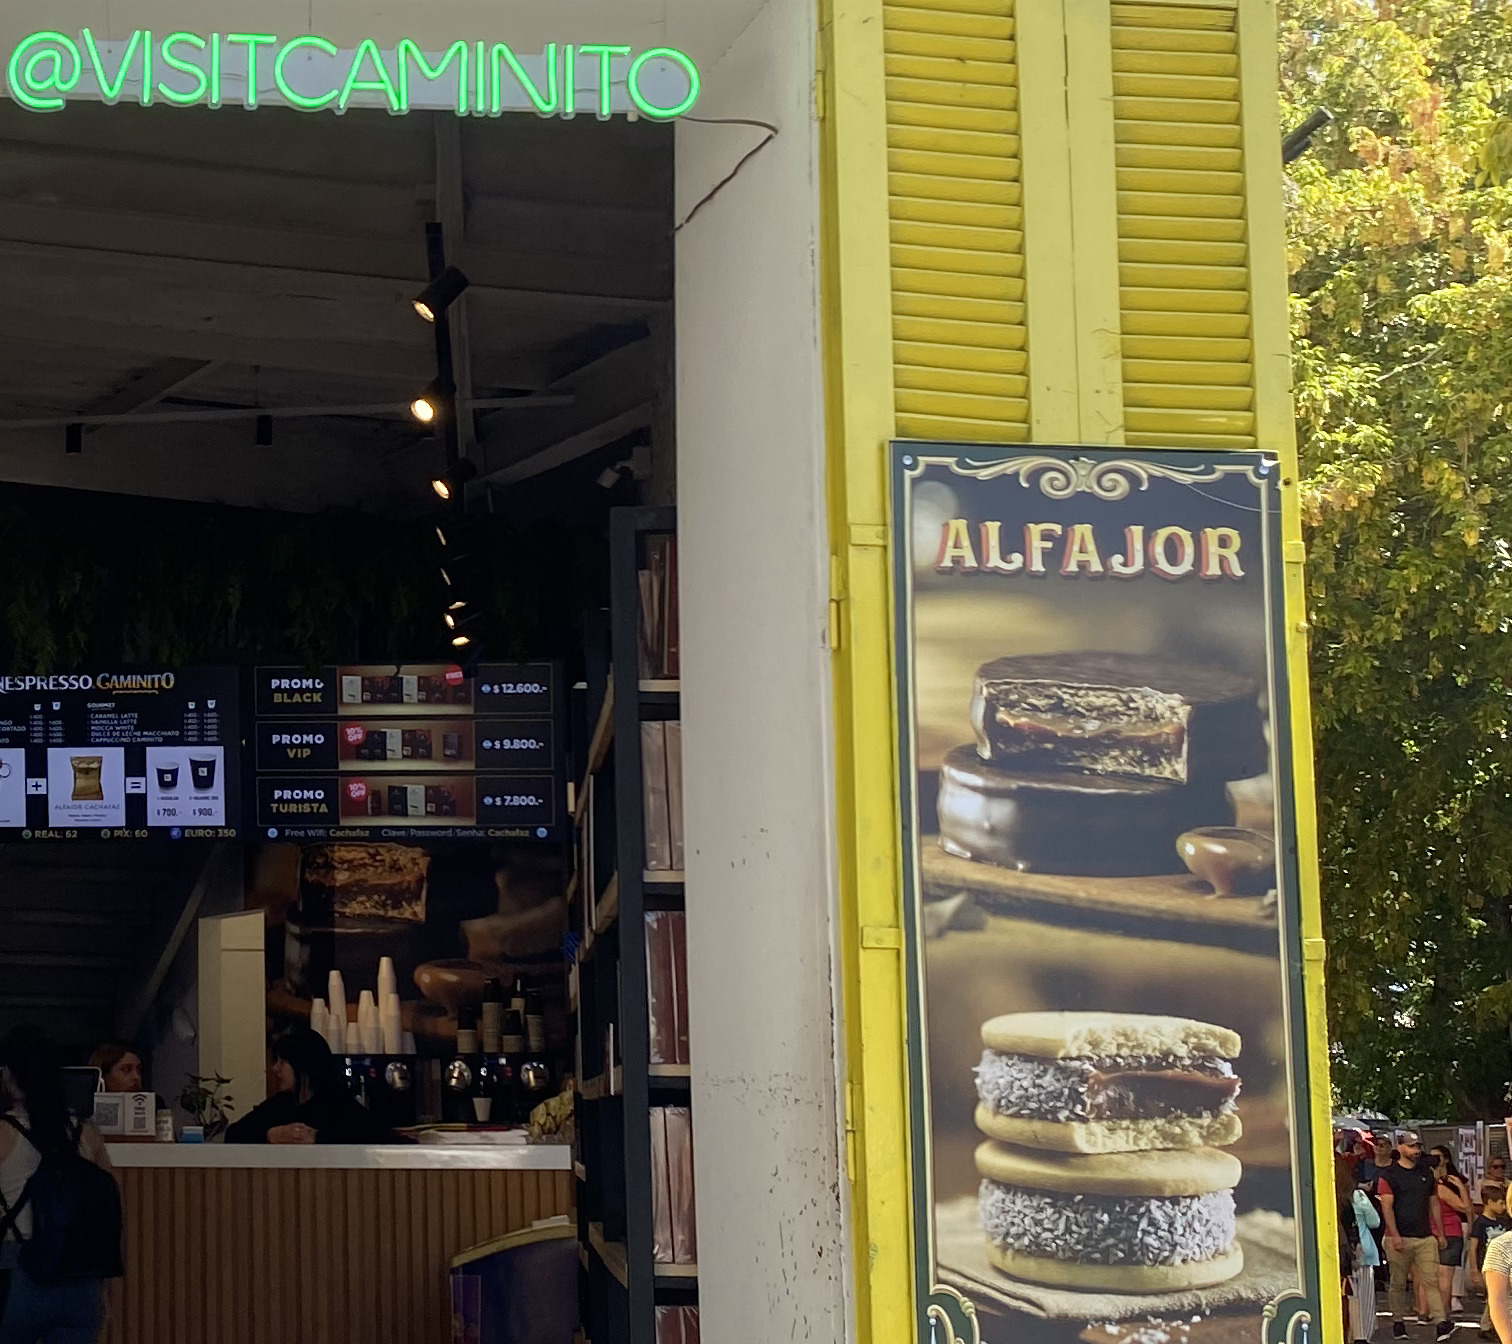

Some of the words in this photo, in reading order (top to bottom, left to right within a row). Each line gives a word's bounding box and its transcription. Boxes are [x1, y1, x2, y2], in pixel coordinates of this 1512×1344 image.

[5, 27, 702, 119] @VISITCAMINITO
[936, 518, 1245, 582] ALFAJOR
[96, 672, 175, 689] CAMINITO
[271, 678, 324, 689] PROMO
[273, 692, 322, 703] BLACK
[272, 734, 325, 745] PROMO
[286, 748, 311, 758] VIP
[274, 790, 325, 800] PROMO
[270, 803, 328, 813] TURISTA
[35, 830, 63, 838] REAL:
[184, 829, 215, 837] EURO:
[217, 828, 236, 837] 350
